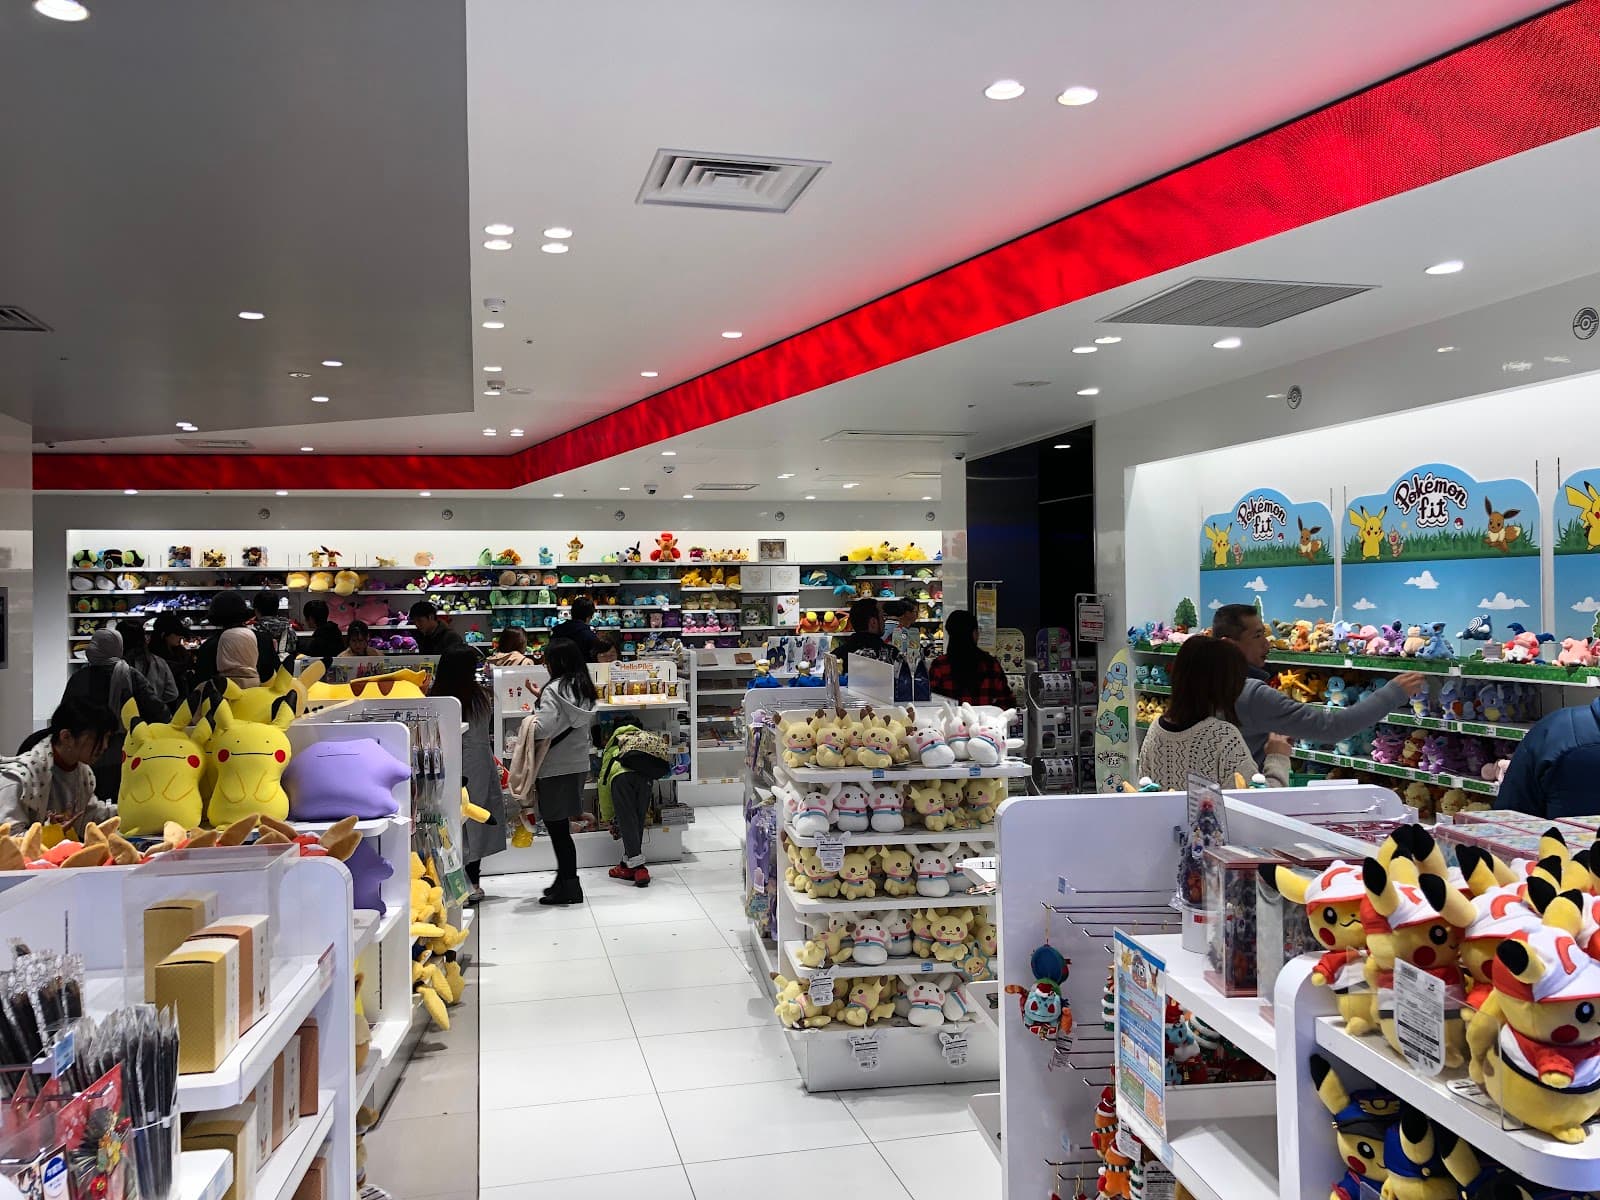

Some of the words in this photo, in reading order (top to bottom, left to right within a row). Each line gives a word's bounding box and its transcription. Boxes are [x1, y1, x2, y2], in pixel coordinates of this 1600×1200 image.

[1395, 475, 1466, 512] Pokémon
[1237, 498, 1286, 528] Pokémon
[1419, 497, 1446, 520] fit
[1253, 515, 1272, 534] fit
